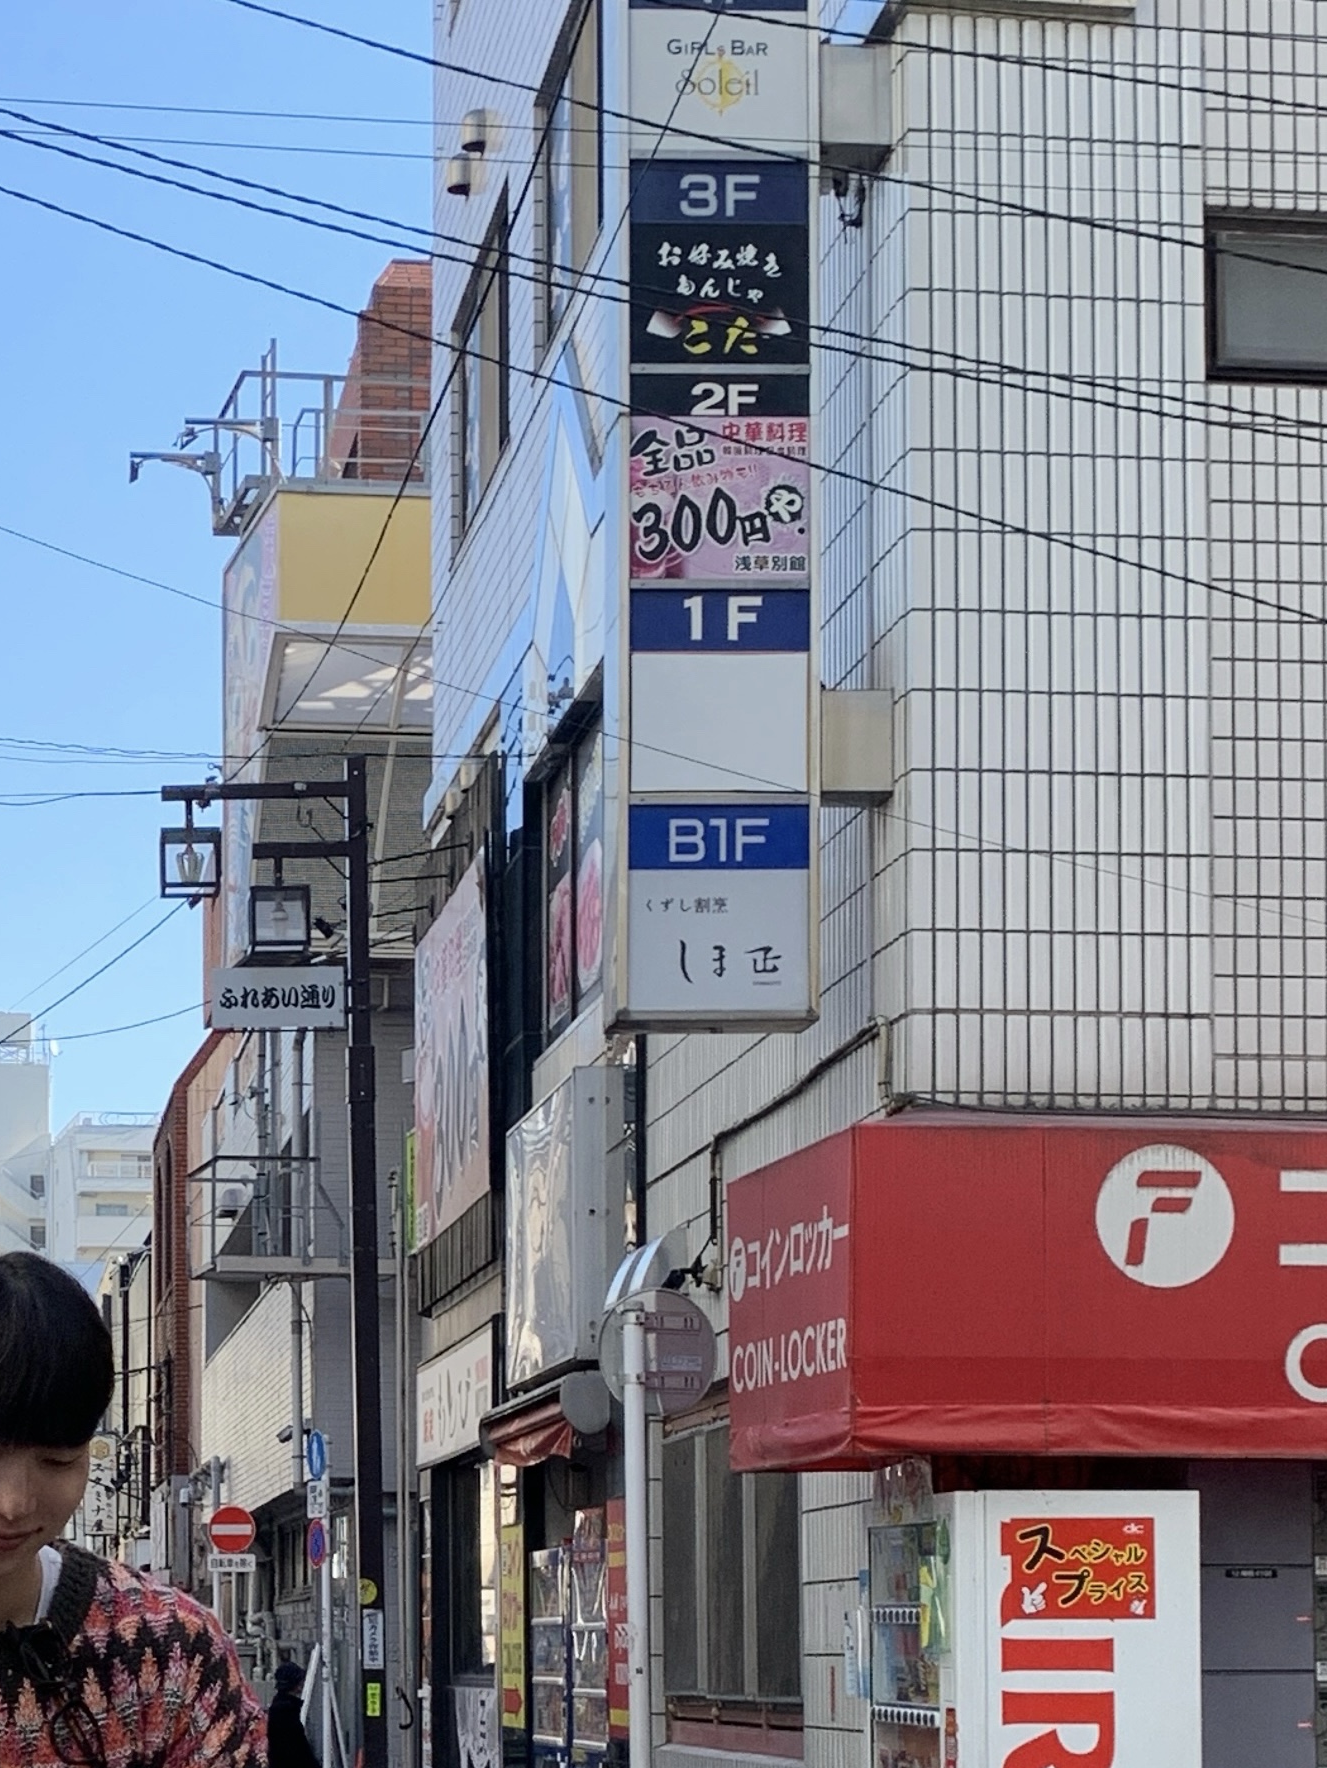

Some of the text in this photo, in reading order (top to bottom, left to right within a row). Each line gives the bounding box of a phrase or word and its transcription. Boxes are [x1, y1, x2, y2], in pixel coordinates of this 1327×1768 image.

[731, 39, 769, 56] BAR
[675, 68, 759, 96] Soleil
[679, 174, 761, 217] 3F
[658, 241, 782, 278] お好み焼き
[676, 276, 764, 303] もんじゃ
[690, 382, 760, 416] 2F
[722, 421, 807, 443] 中華料理
[630, 429, 716, 477] 全品
[684, 596, 763, 640] 1F
[668, 818, 770, 862] B1F
[219, 984, 336, 1010] ふれあい通り
[747, 1205, 849, 1290] コインロッカー
[732, 1317, 847, 1393] COIN-LOCKER
[1017, 1524, 1146, 1572] スペシャル
[1053, 1569, 1148, 1606] プライス
